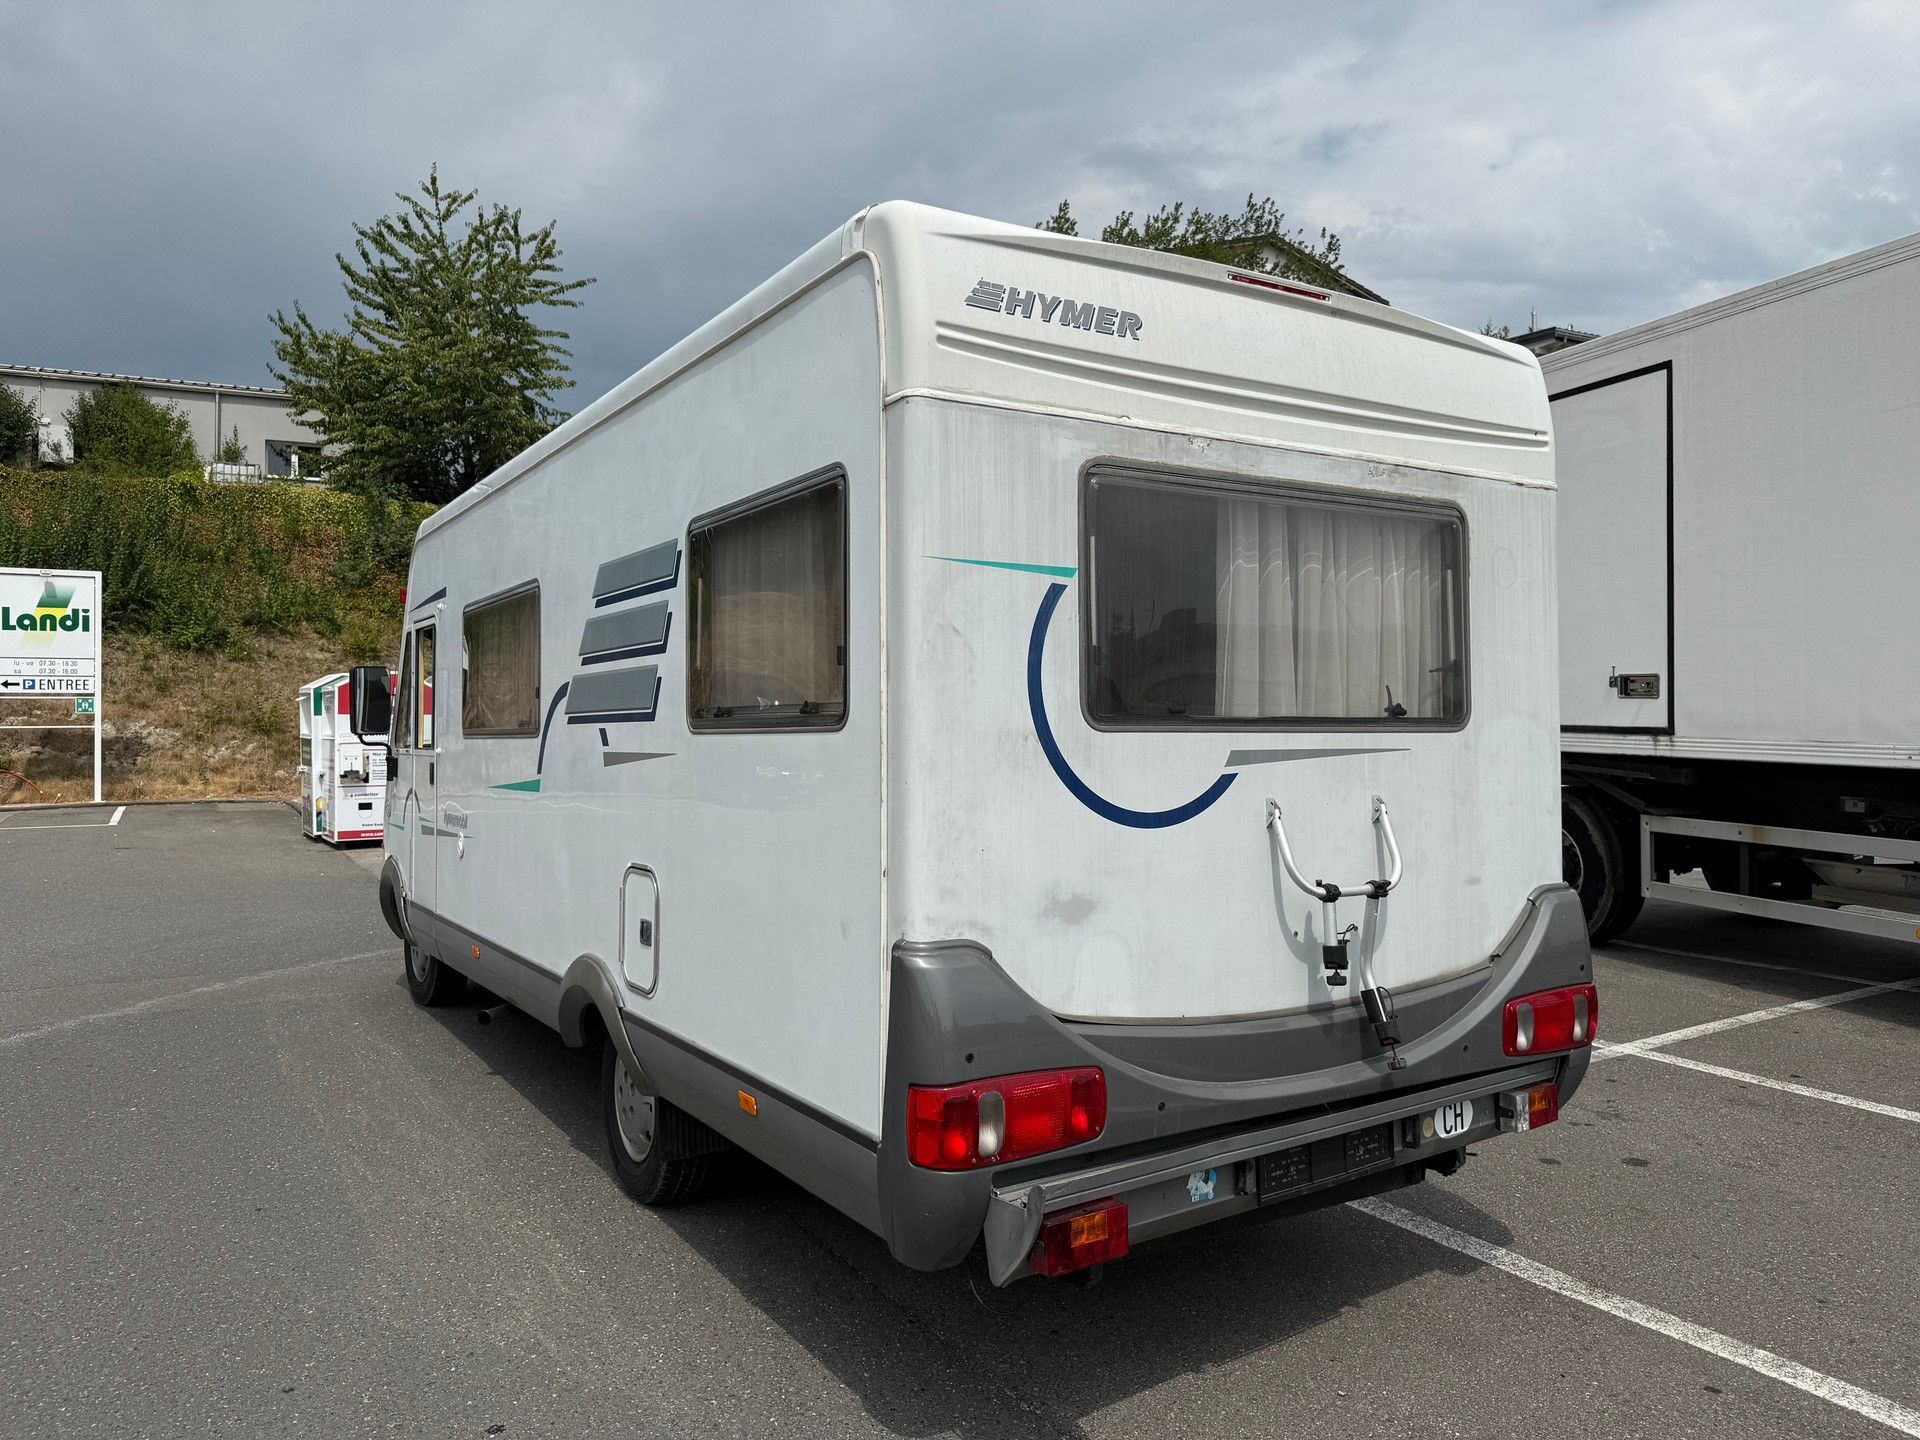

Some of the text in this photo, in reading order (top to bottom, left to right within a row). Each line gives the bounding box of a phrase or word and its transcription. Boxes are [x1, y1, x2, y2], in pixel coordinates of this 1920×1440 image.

[1003, 286, 1143, 341] HYMER
[2, 606, 90, 632] Landi
[39, 679, 90, 691] ENTREE
[1443, 1101, 1464, 1134] CH
